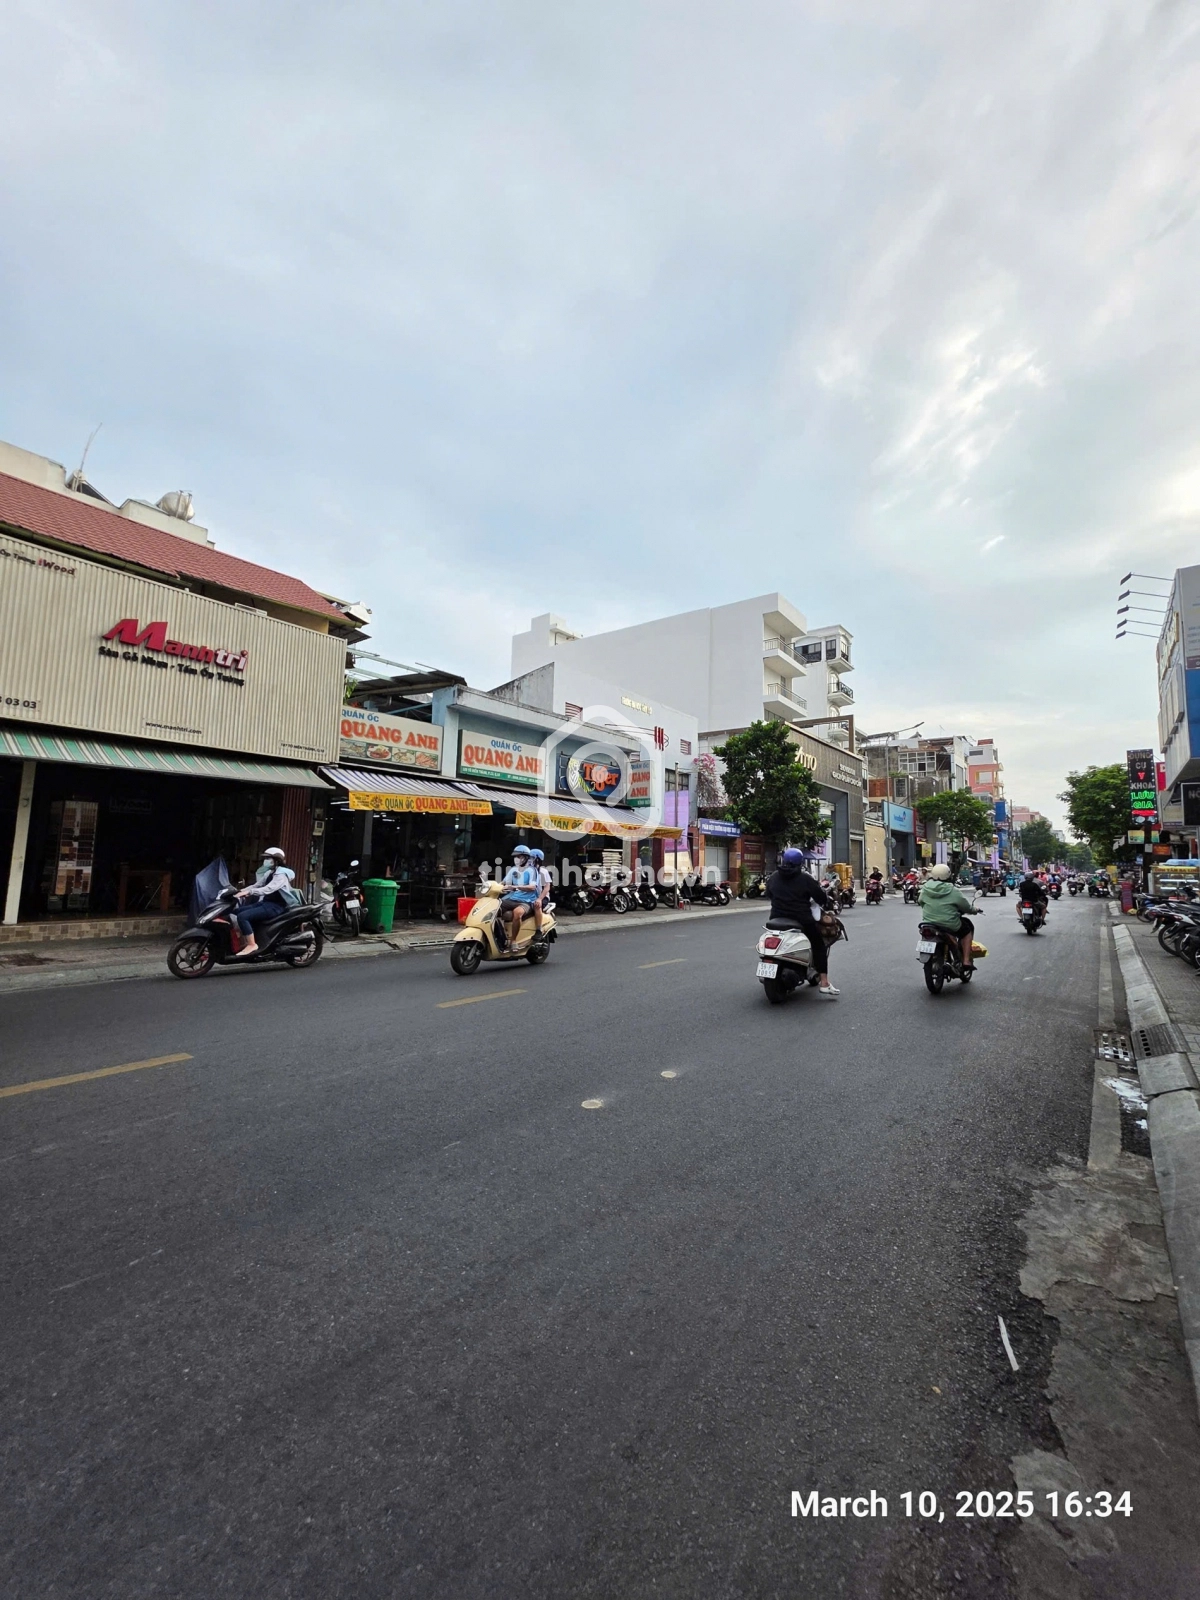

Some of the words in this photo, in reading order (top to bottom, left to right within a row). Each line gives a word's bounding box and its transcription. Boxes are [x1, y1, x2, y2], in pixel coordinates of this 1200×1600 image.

[38, 557, 76, 575] iWood
[23, 700, 37, 709] 03
[342, 709, 365, 720] QUÁN
[367, 713, 379, 723] ỐC
[341, 719, 402, 744] QUANG
[405, 732, 439, 751] ANH
[491, 739, 511, 750] QUÁN
[512, 742, 522, 752] ỐC
[464, 744, 513, 769] QUANG
[515, 755, 543, 775] ANH
[1129, 751, 1151, 761] DỤNG
[1136, 761, 1147, 770] CỤ
[630, 786, 648, 798] ANH
[1131, 782, 1154, 790] KHOA
[385, 796, 404, 810] QUÁN
[405, 796, 415, 810] ỐC
[415, 797, 449, 811] QUANG
[449, 799, 469, 811] ANH
[543, 818, 569, 830] QUÁN
[571, 818, 583, 831] ỐC
[584, 820, 623, 834] QUANG
